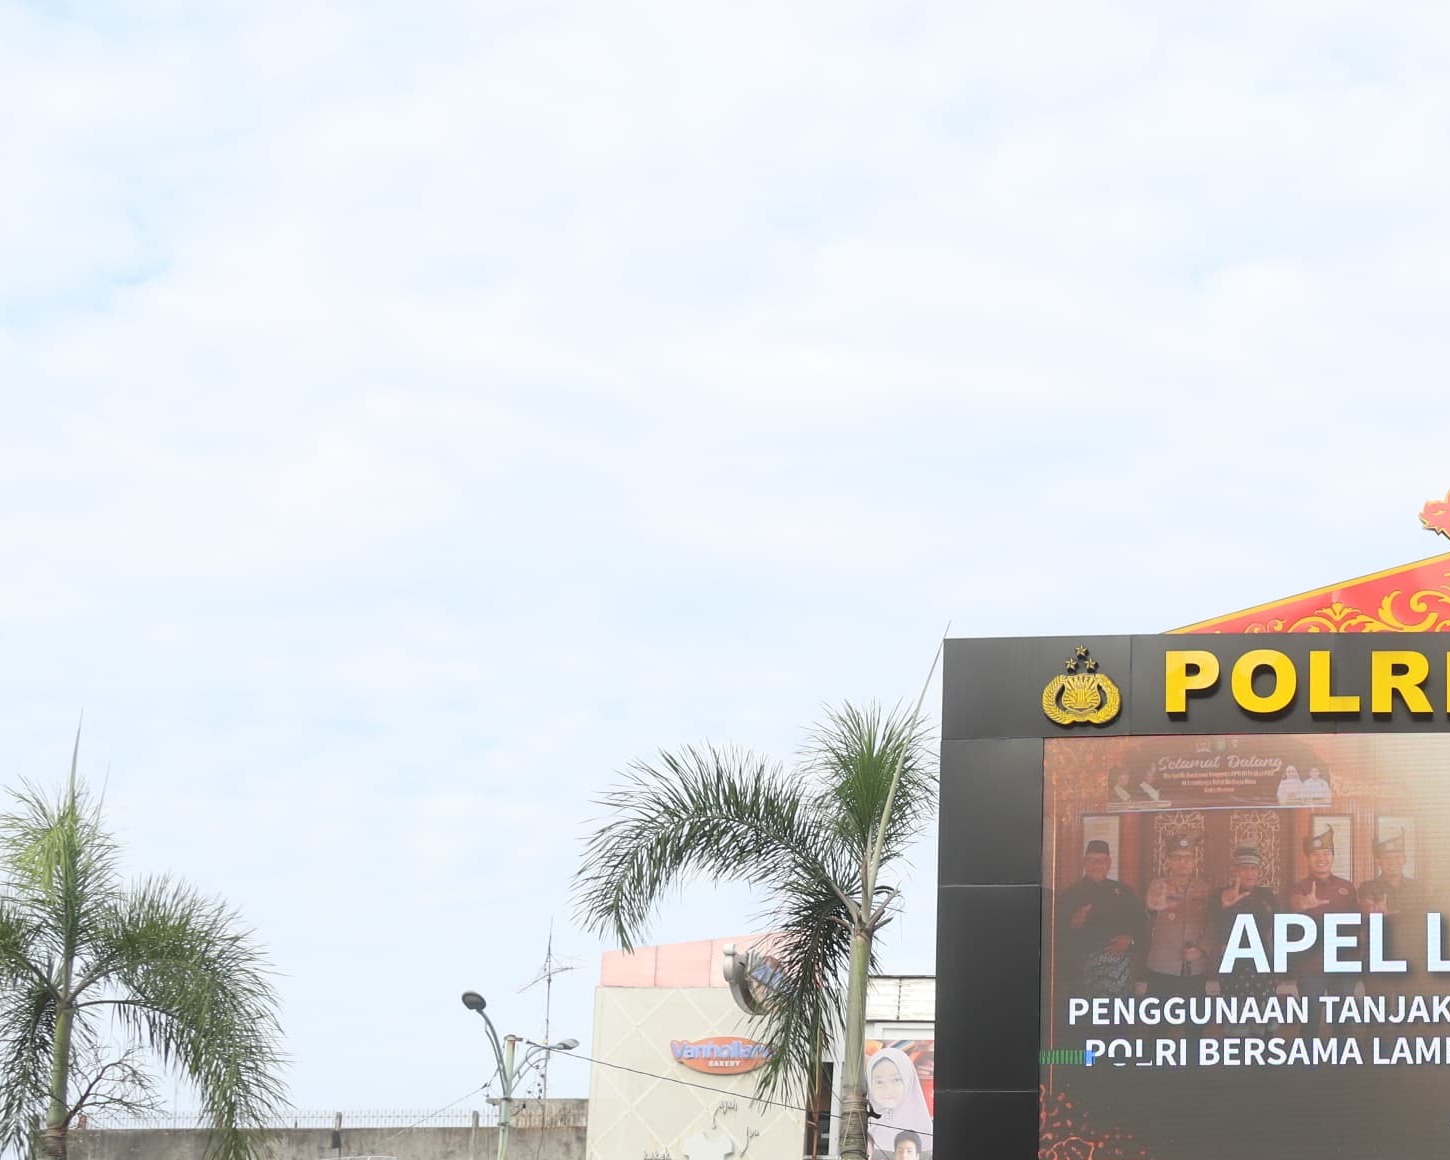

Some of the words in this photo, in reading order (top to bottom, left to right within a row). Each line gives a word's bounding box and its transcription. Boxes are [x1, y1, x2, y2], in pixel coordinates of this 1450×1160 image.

[1218, 912, 1408, 975] APEL
[1068, 996, 1309, 1025] PENGGUNAAN
[1085, 1038, 1187, 1067] POLRI
[1199, 1037, 1364, 1066] BERSAMA
